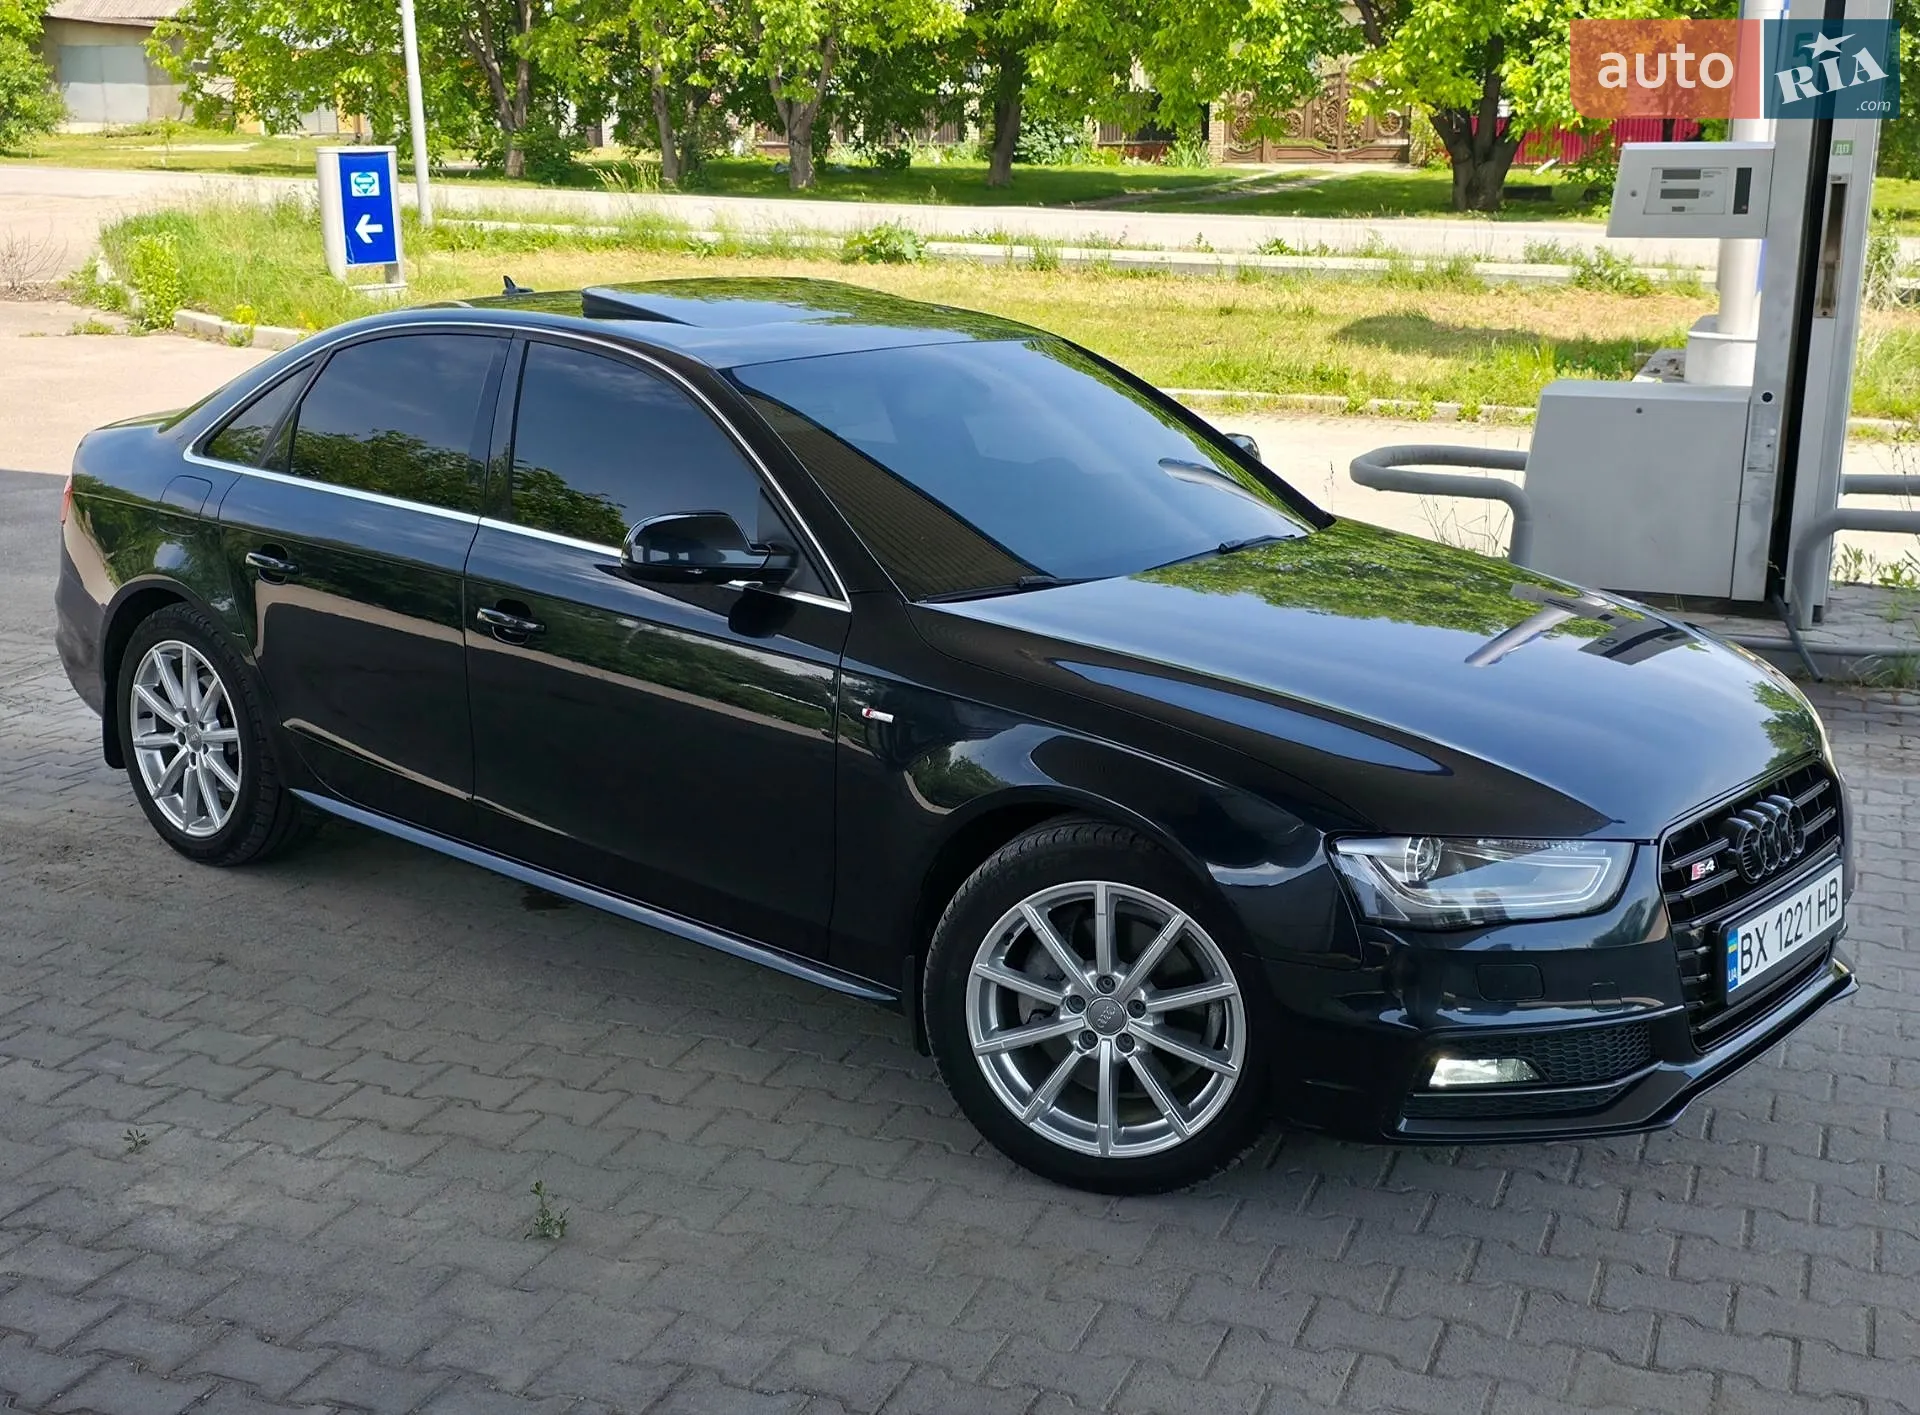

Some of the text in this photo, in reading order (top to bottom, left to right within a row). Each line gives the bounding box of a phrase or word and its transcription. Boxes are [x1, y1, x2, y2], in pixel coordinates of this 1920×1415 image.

[1696, 858, 1715, 875] S4
[1741, 877, 1838, 977] BX 1221 HB
